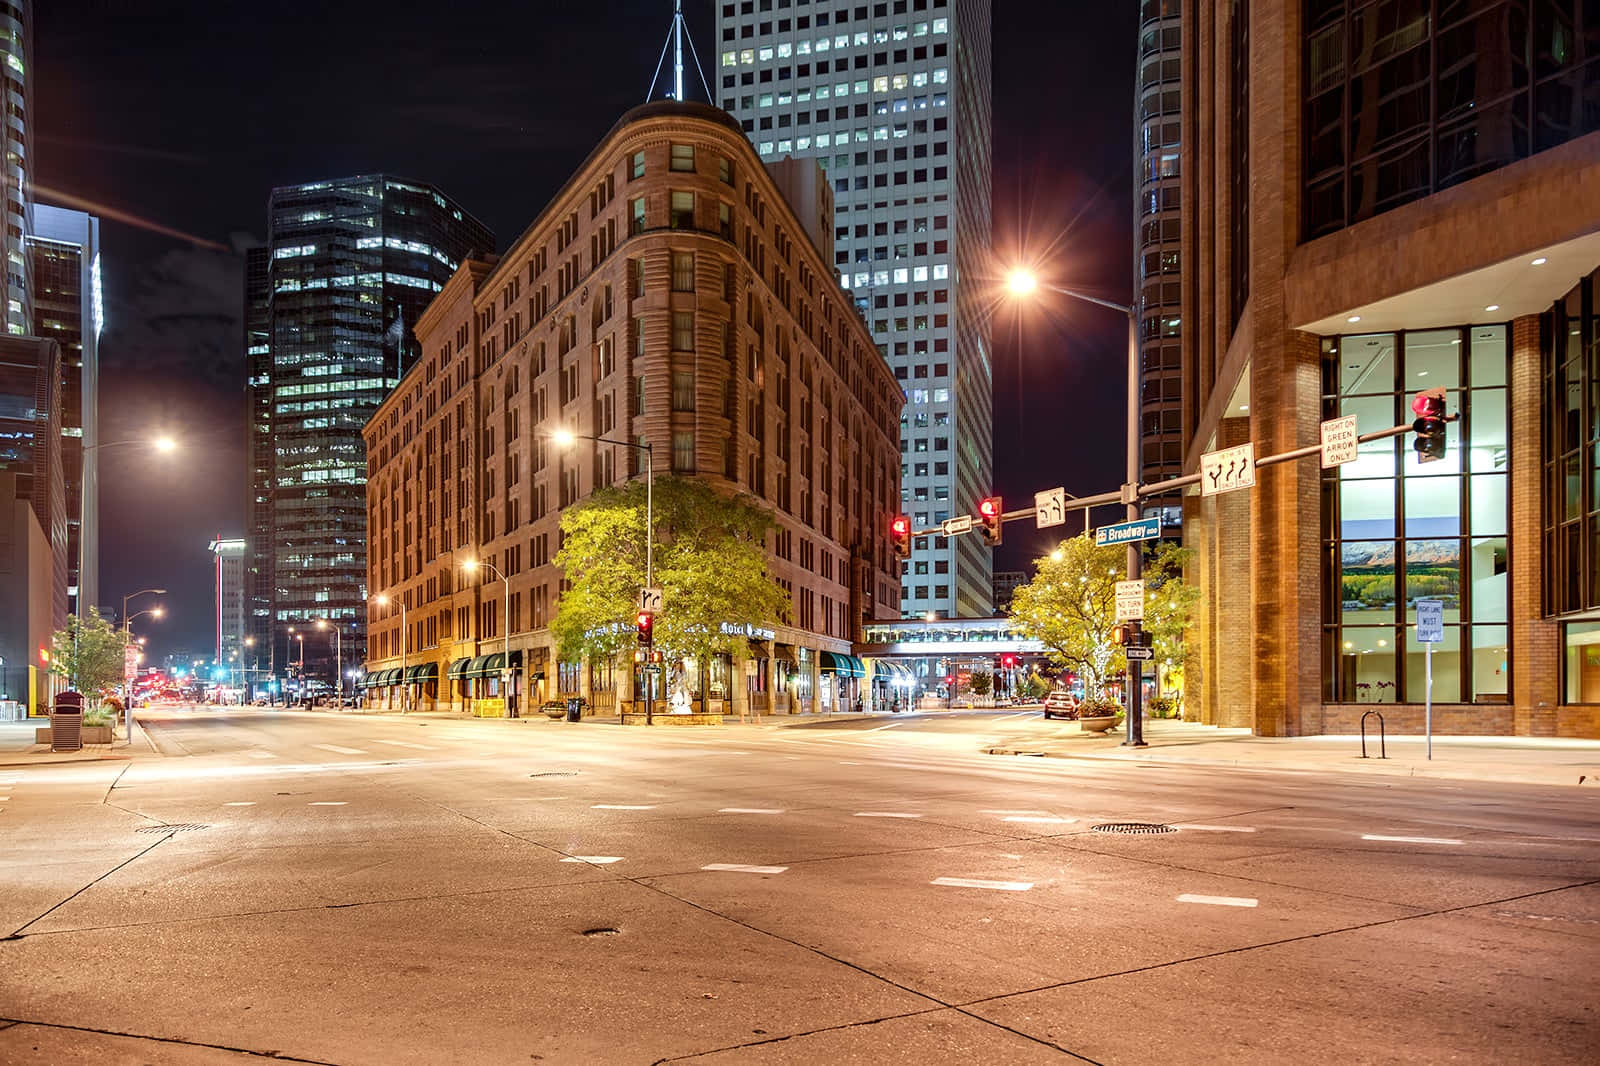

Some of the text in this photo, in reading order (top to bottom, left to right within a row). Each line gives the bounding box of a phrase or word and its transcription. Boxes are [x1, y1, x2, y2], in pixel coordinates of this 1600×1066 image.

[1324, 420, 1354, 432] RIGHT ON
[1328, 431, 1352, 442] GREEN
[1327, 441, 1354, 451] ARROW
[1330, 451, 1351, 463] ONLY
[1108, 526, 1146, 541] Broadway
[1128, 600, 1141, 608] TURN
[1423, 617, 1437, 625] MUST
